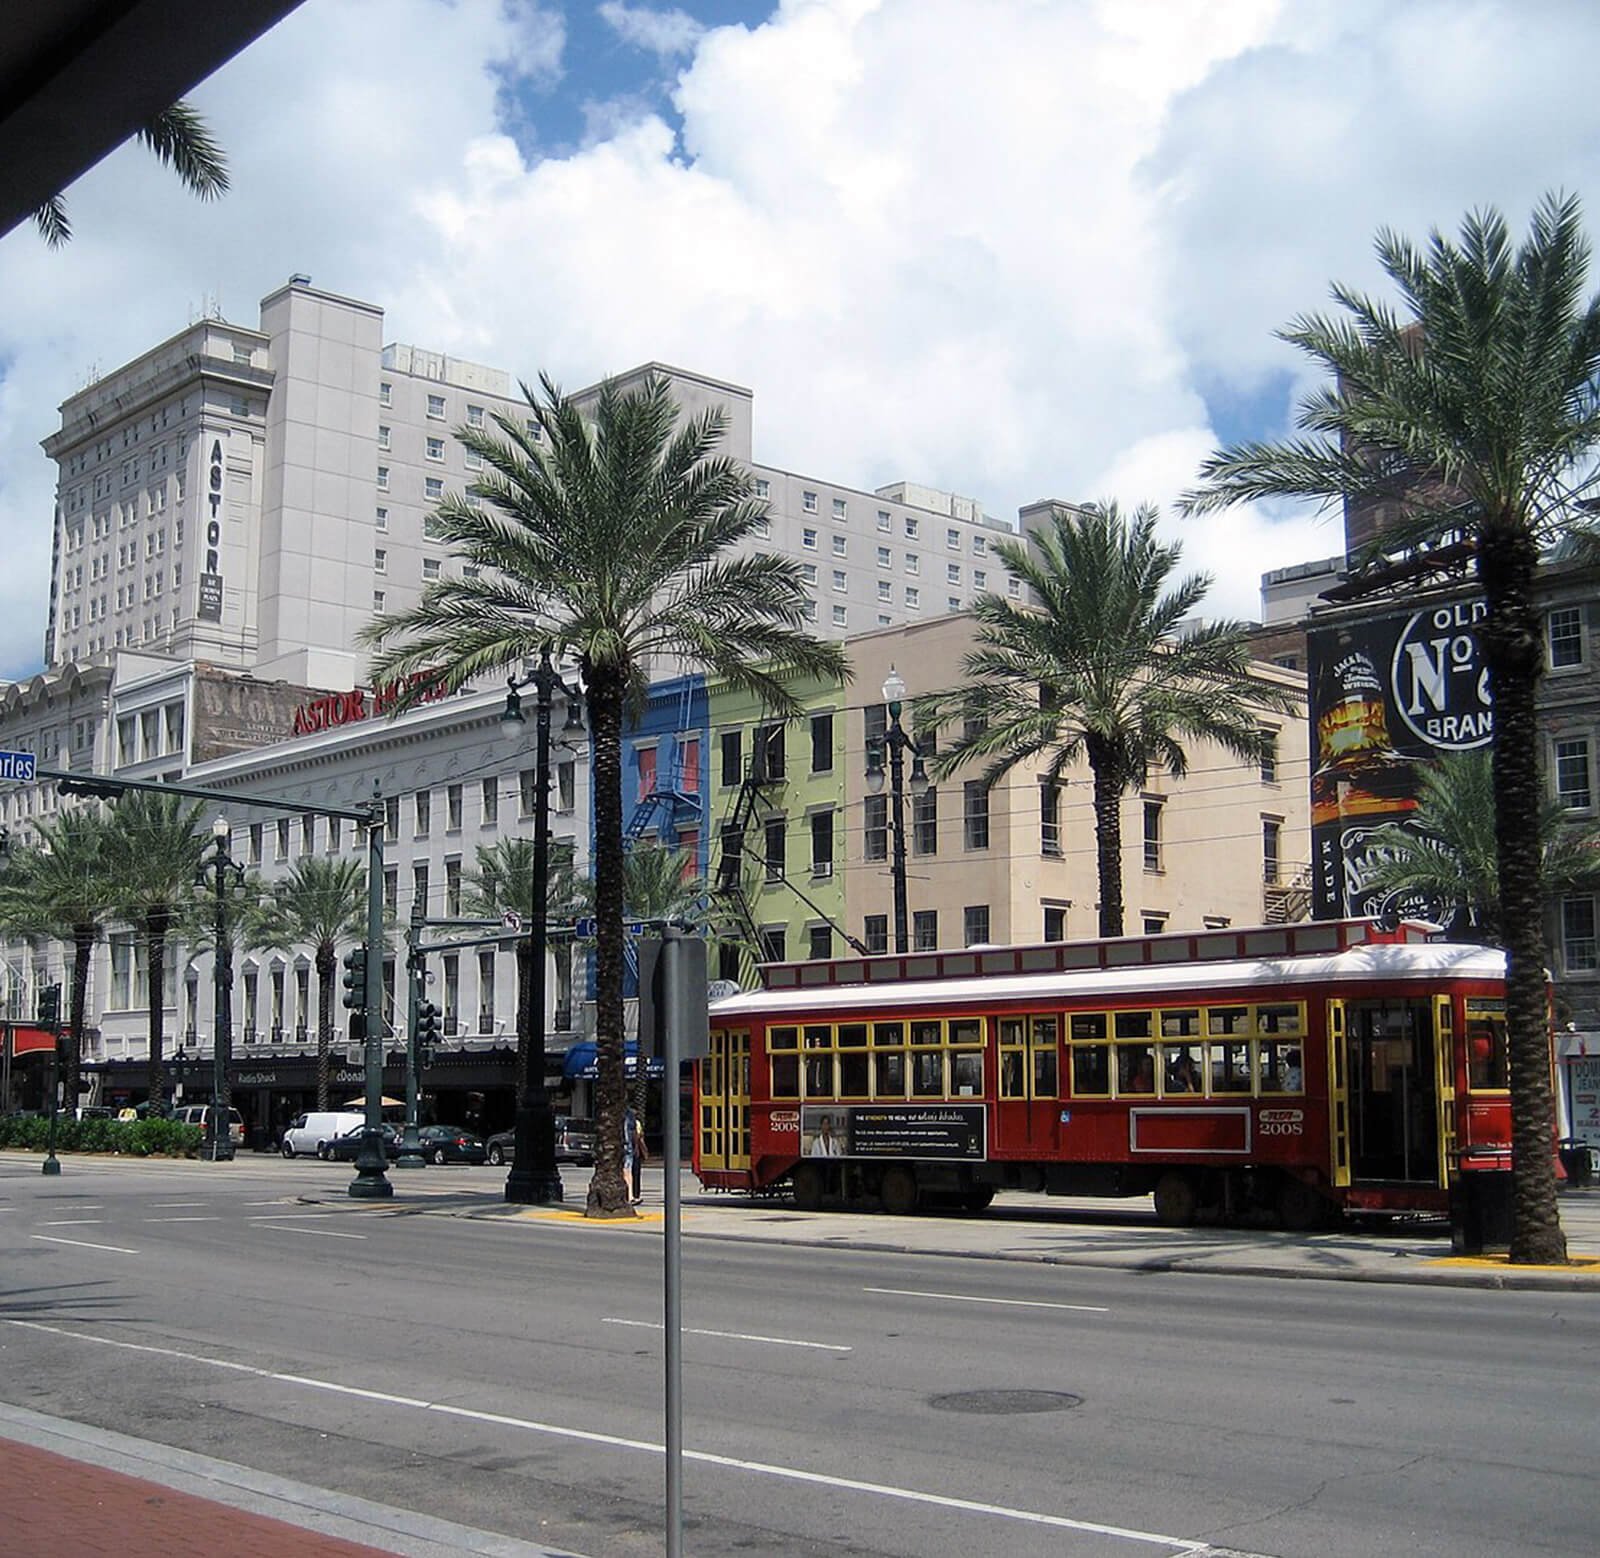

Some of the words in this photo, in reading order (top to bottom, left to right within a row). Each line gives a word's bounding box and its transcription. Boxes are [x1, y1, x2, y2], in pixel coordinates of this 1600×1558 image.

[206, 439, 222, 576] ASTOR
[291, 689, 366, 737] ASTOR
[1427, 711, 1493, 742] BRAN
[0, 754, 33, 780] rles
[1321, 840, 1336, 903] MADE
[770, 1122, 800, 1133] 2008
[1259, 1122, 1304, 1136] 2008
